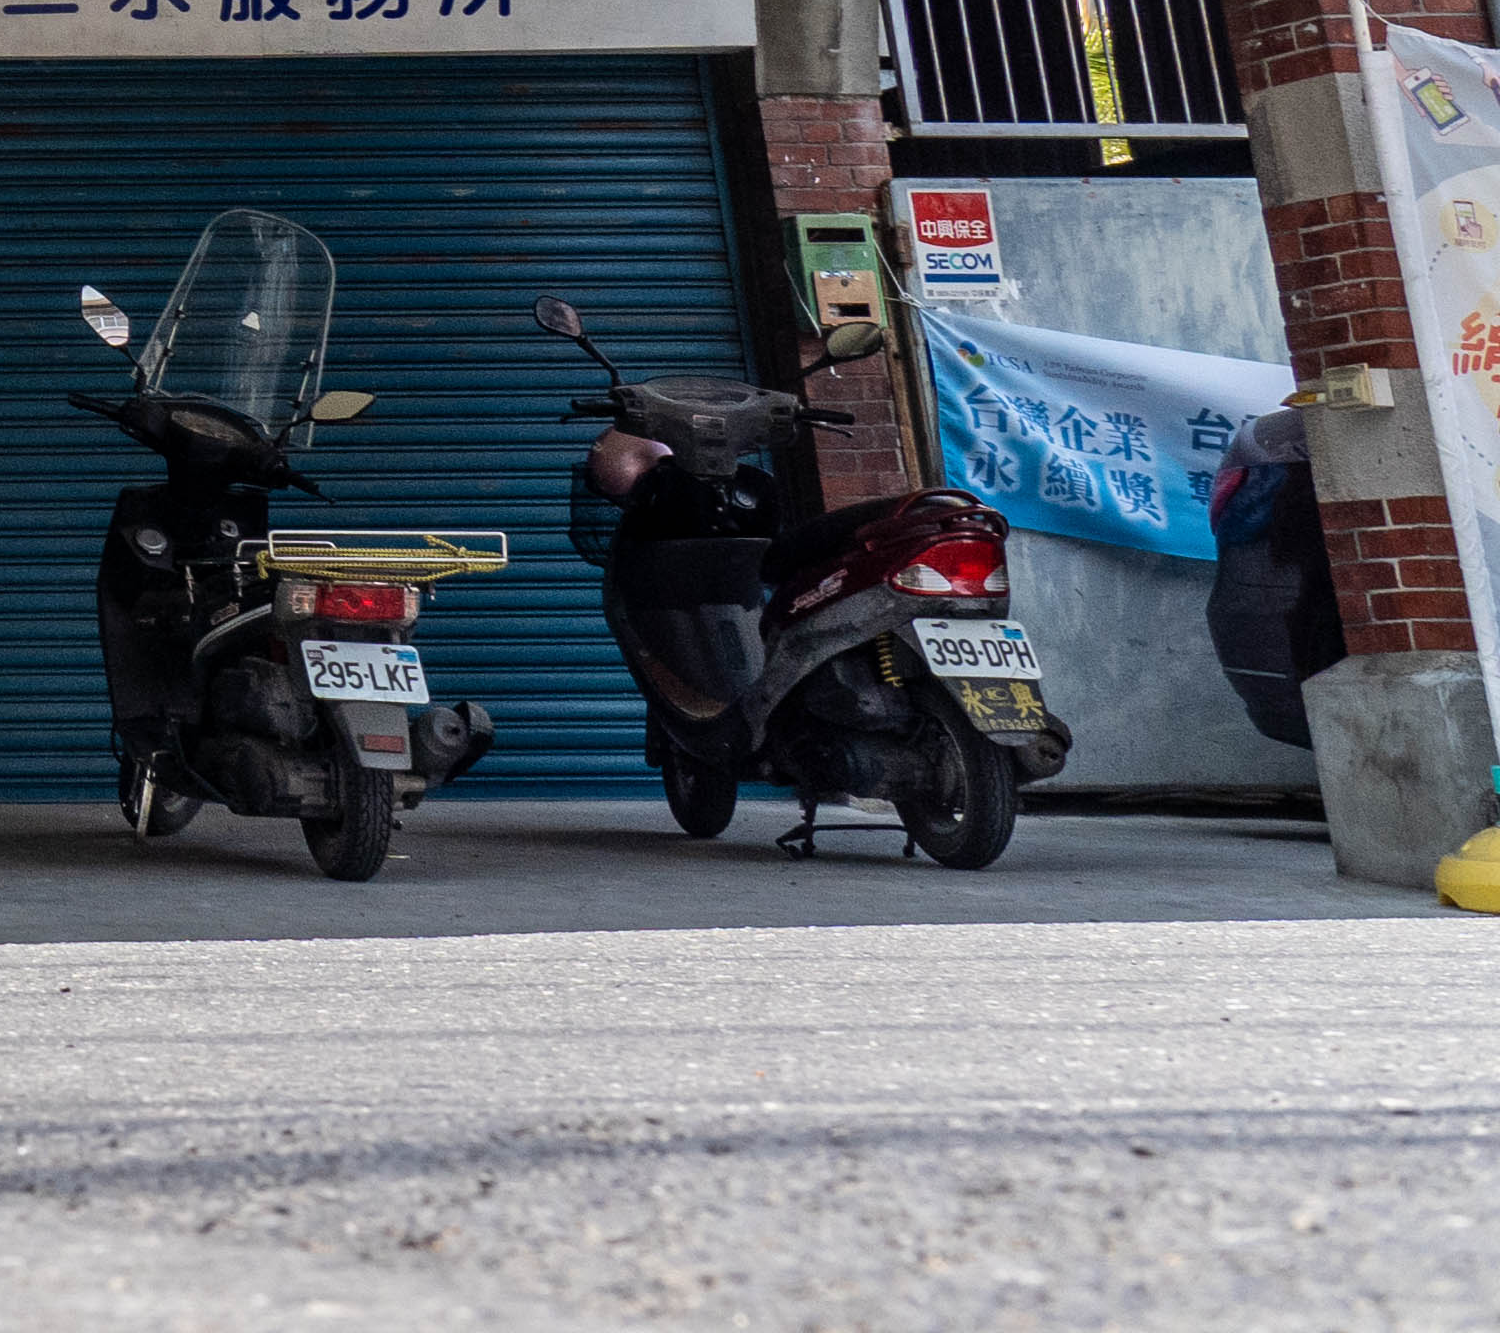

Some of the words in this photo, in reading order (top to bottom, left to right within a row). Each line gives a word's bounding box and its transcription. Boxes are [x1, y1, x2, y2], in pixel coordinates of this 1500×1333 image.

[920, 219, 988, 239] 中興保全
[926, 252, 993, 270] SECOM
[984, 351, 1034, 374] TCSA
[926, 638, 1037, 669] 399-DPH
[309, 661, 419, 693] 295-LKF
